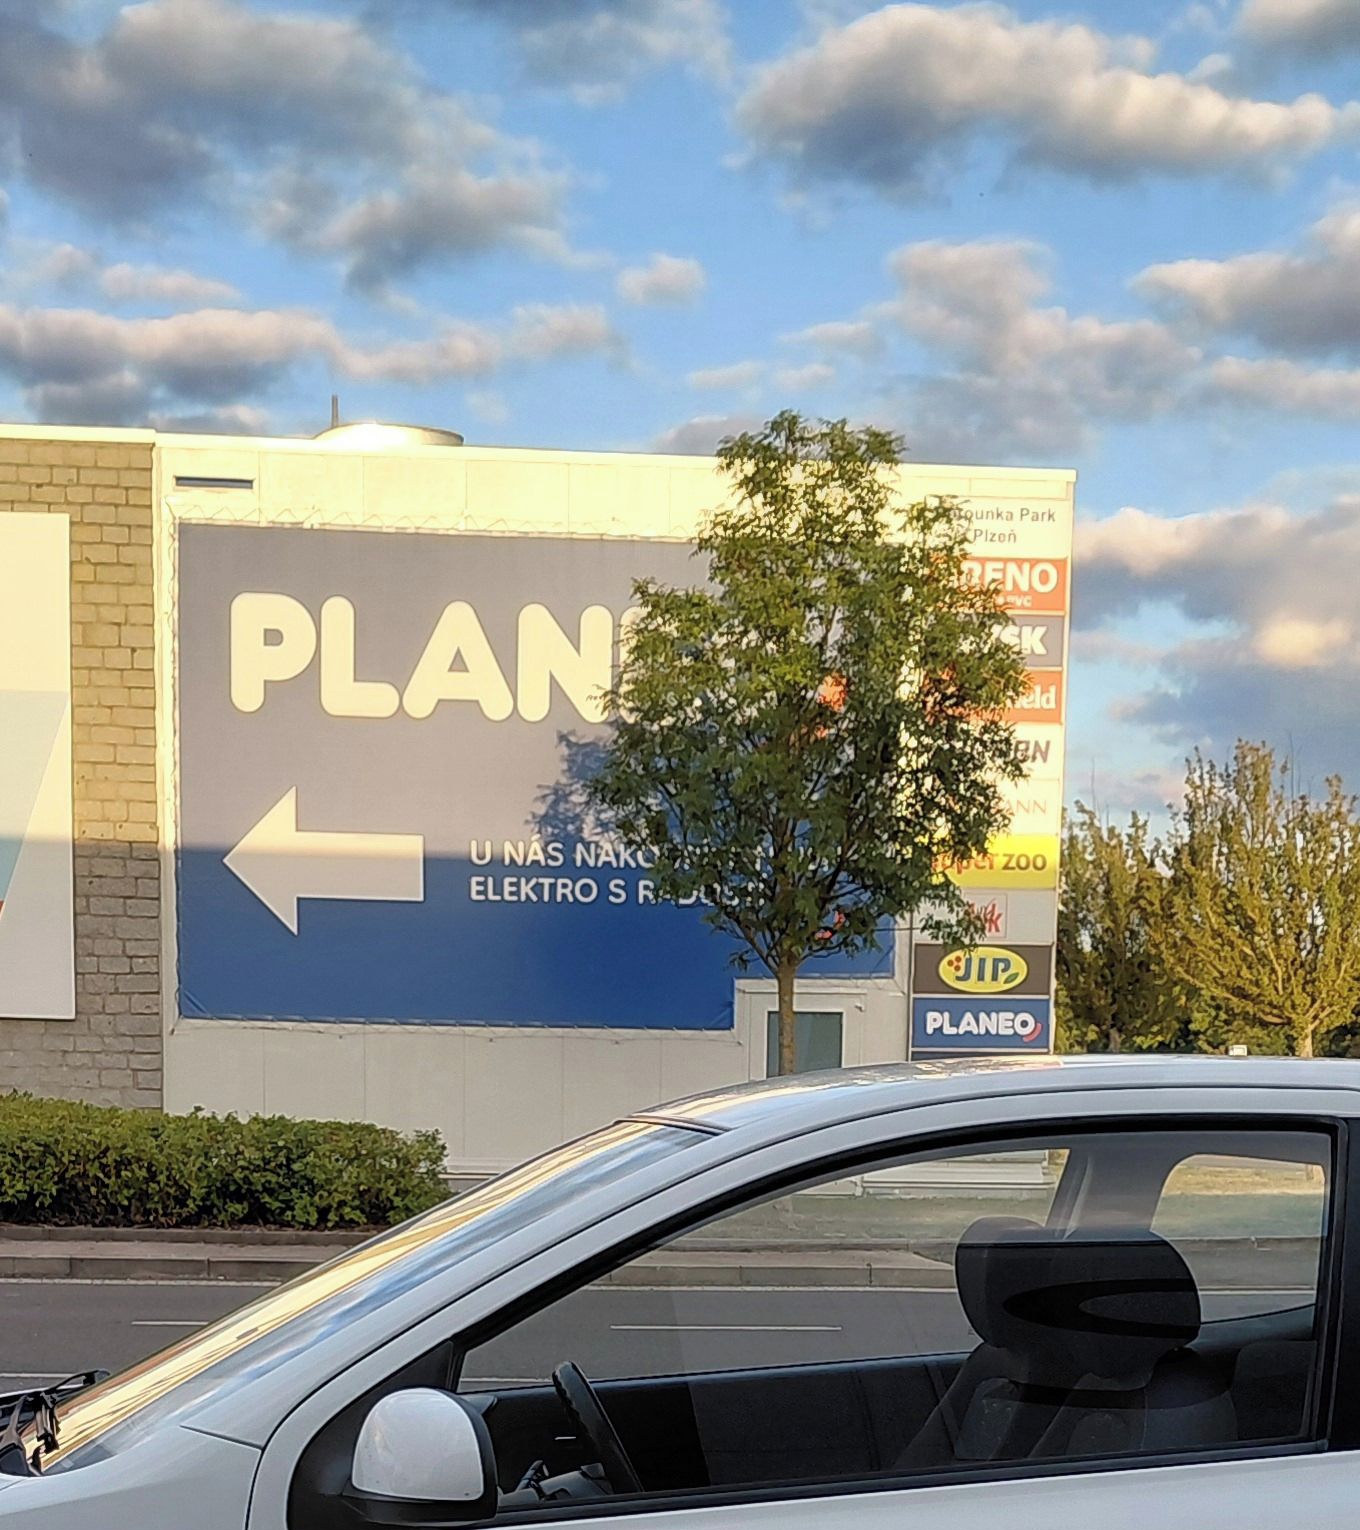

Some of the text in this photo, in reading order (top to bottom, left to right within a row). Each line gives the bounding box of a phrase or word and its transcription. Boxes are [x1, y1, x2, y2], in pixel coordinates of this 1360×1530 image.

[1019, 507, 1057, 522] Park
[469, 839, 493, 867] U
[503, 833, 564, 869] NÁS
[469, 875, 598, 904] ELEKTRO
[608, 878, 627, 904] S
[954, 957, 1012, 983] JIP
[925, 1011, 1037, 1036] PLANEO
